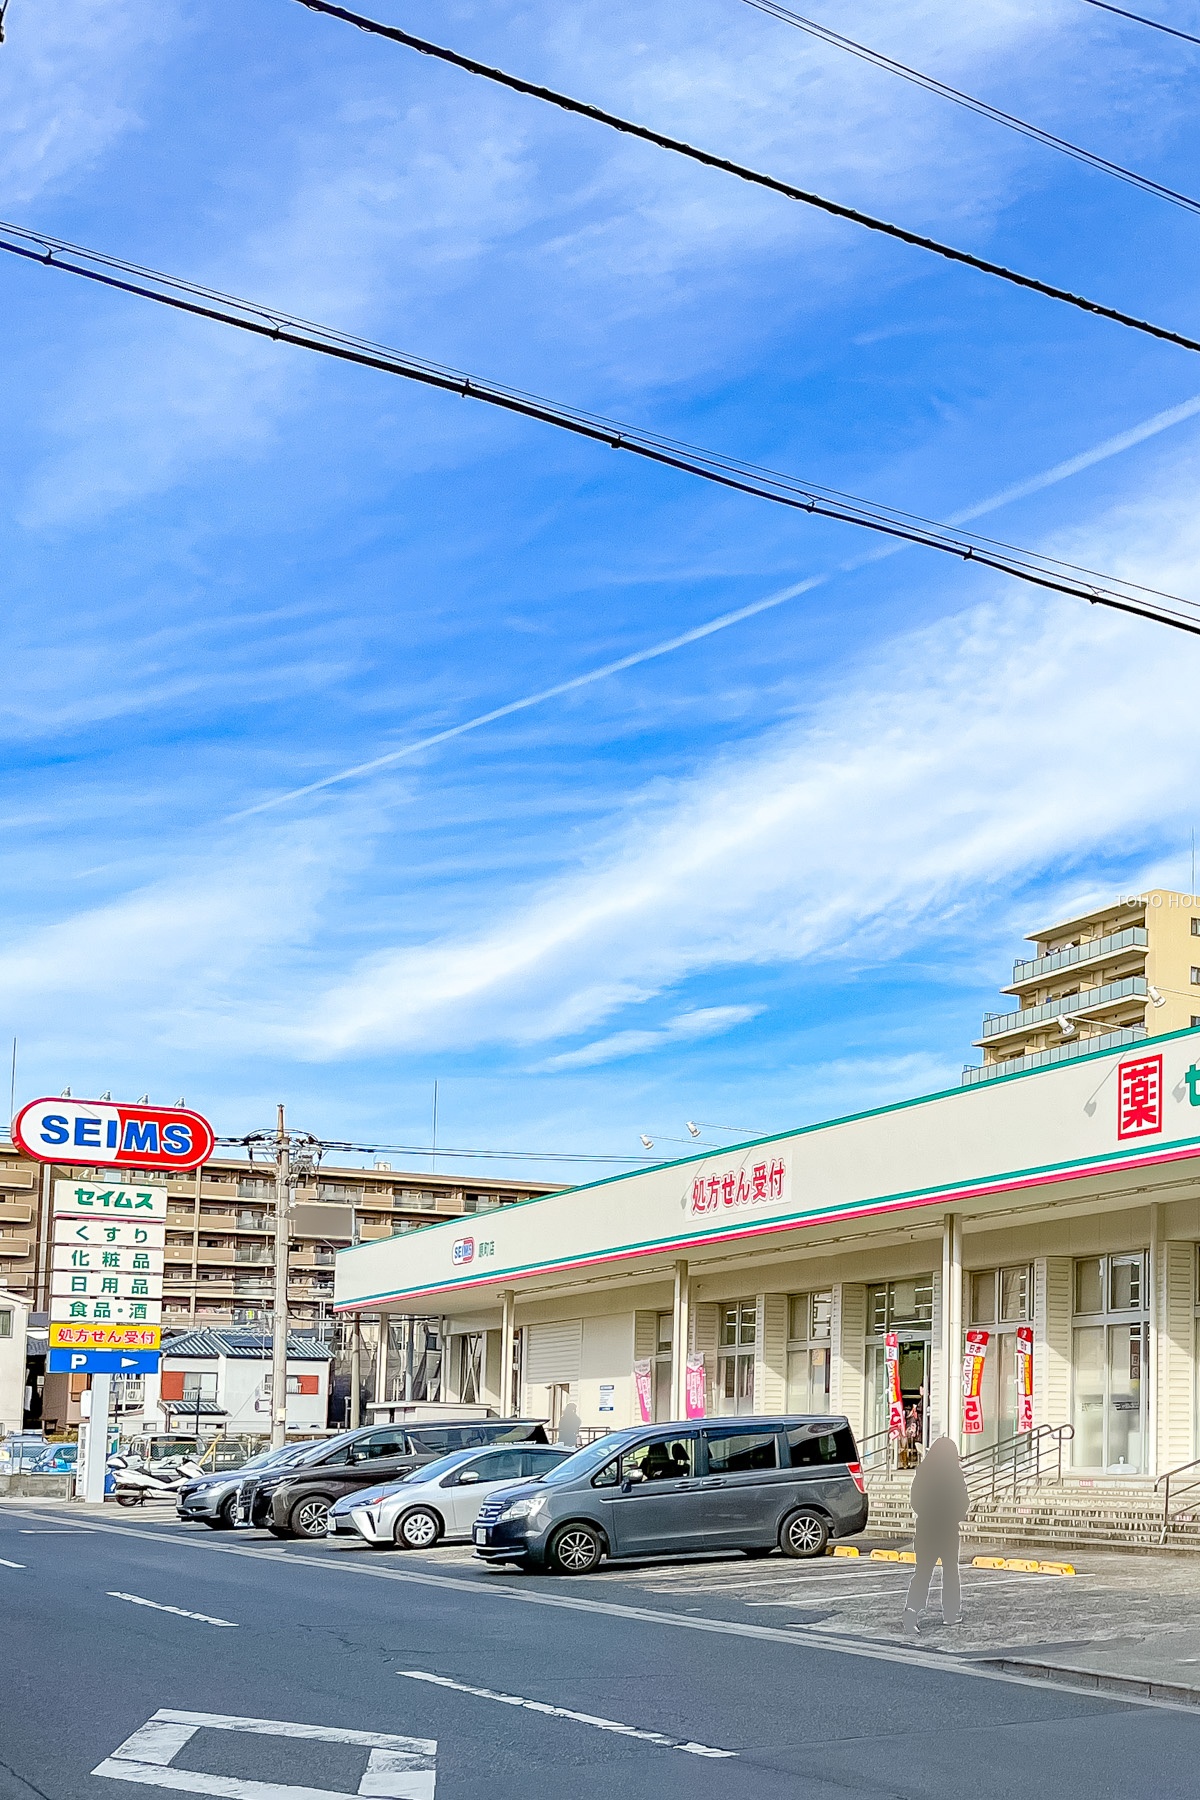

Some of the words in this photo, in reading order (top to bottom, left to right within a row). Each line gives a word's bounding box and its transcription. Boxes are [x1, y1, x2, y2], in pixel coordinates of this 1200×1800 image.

[1122, 1063, 1158, 1132] 薬
[40, 1114, 192, 1155] SEIMS
[691, 1159, 785, 1214] 処方せん受付
[74, 1187, 154, 1211] セイムス
[75, 1225, 148, 1243] くすり
[71, 1249, 150, 1269] 化粧品
[71, 1276, 149, 1295] 日用品
[69, 1301, 148, 1319] 食品・酒
[57, 1327, 156, 1345] 処方せん受付
[70, 1354, 88, 1370] P
